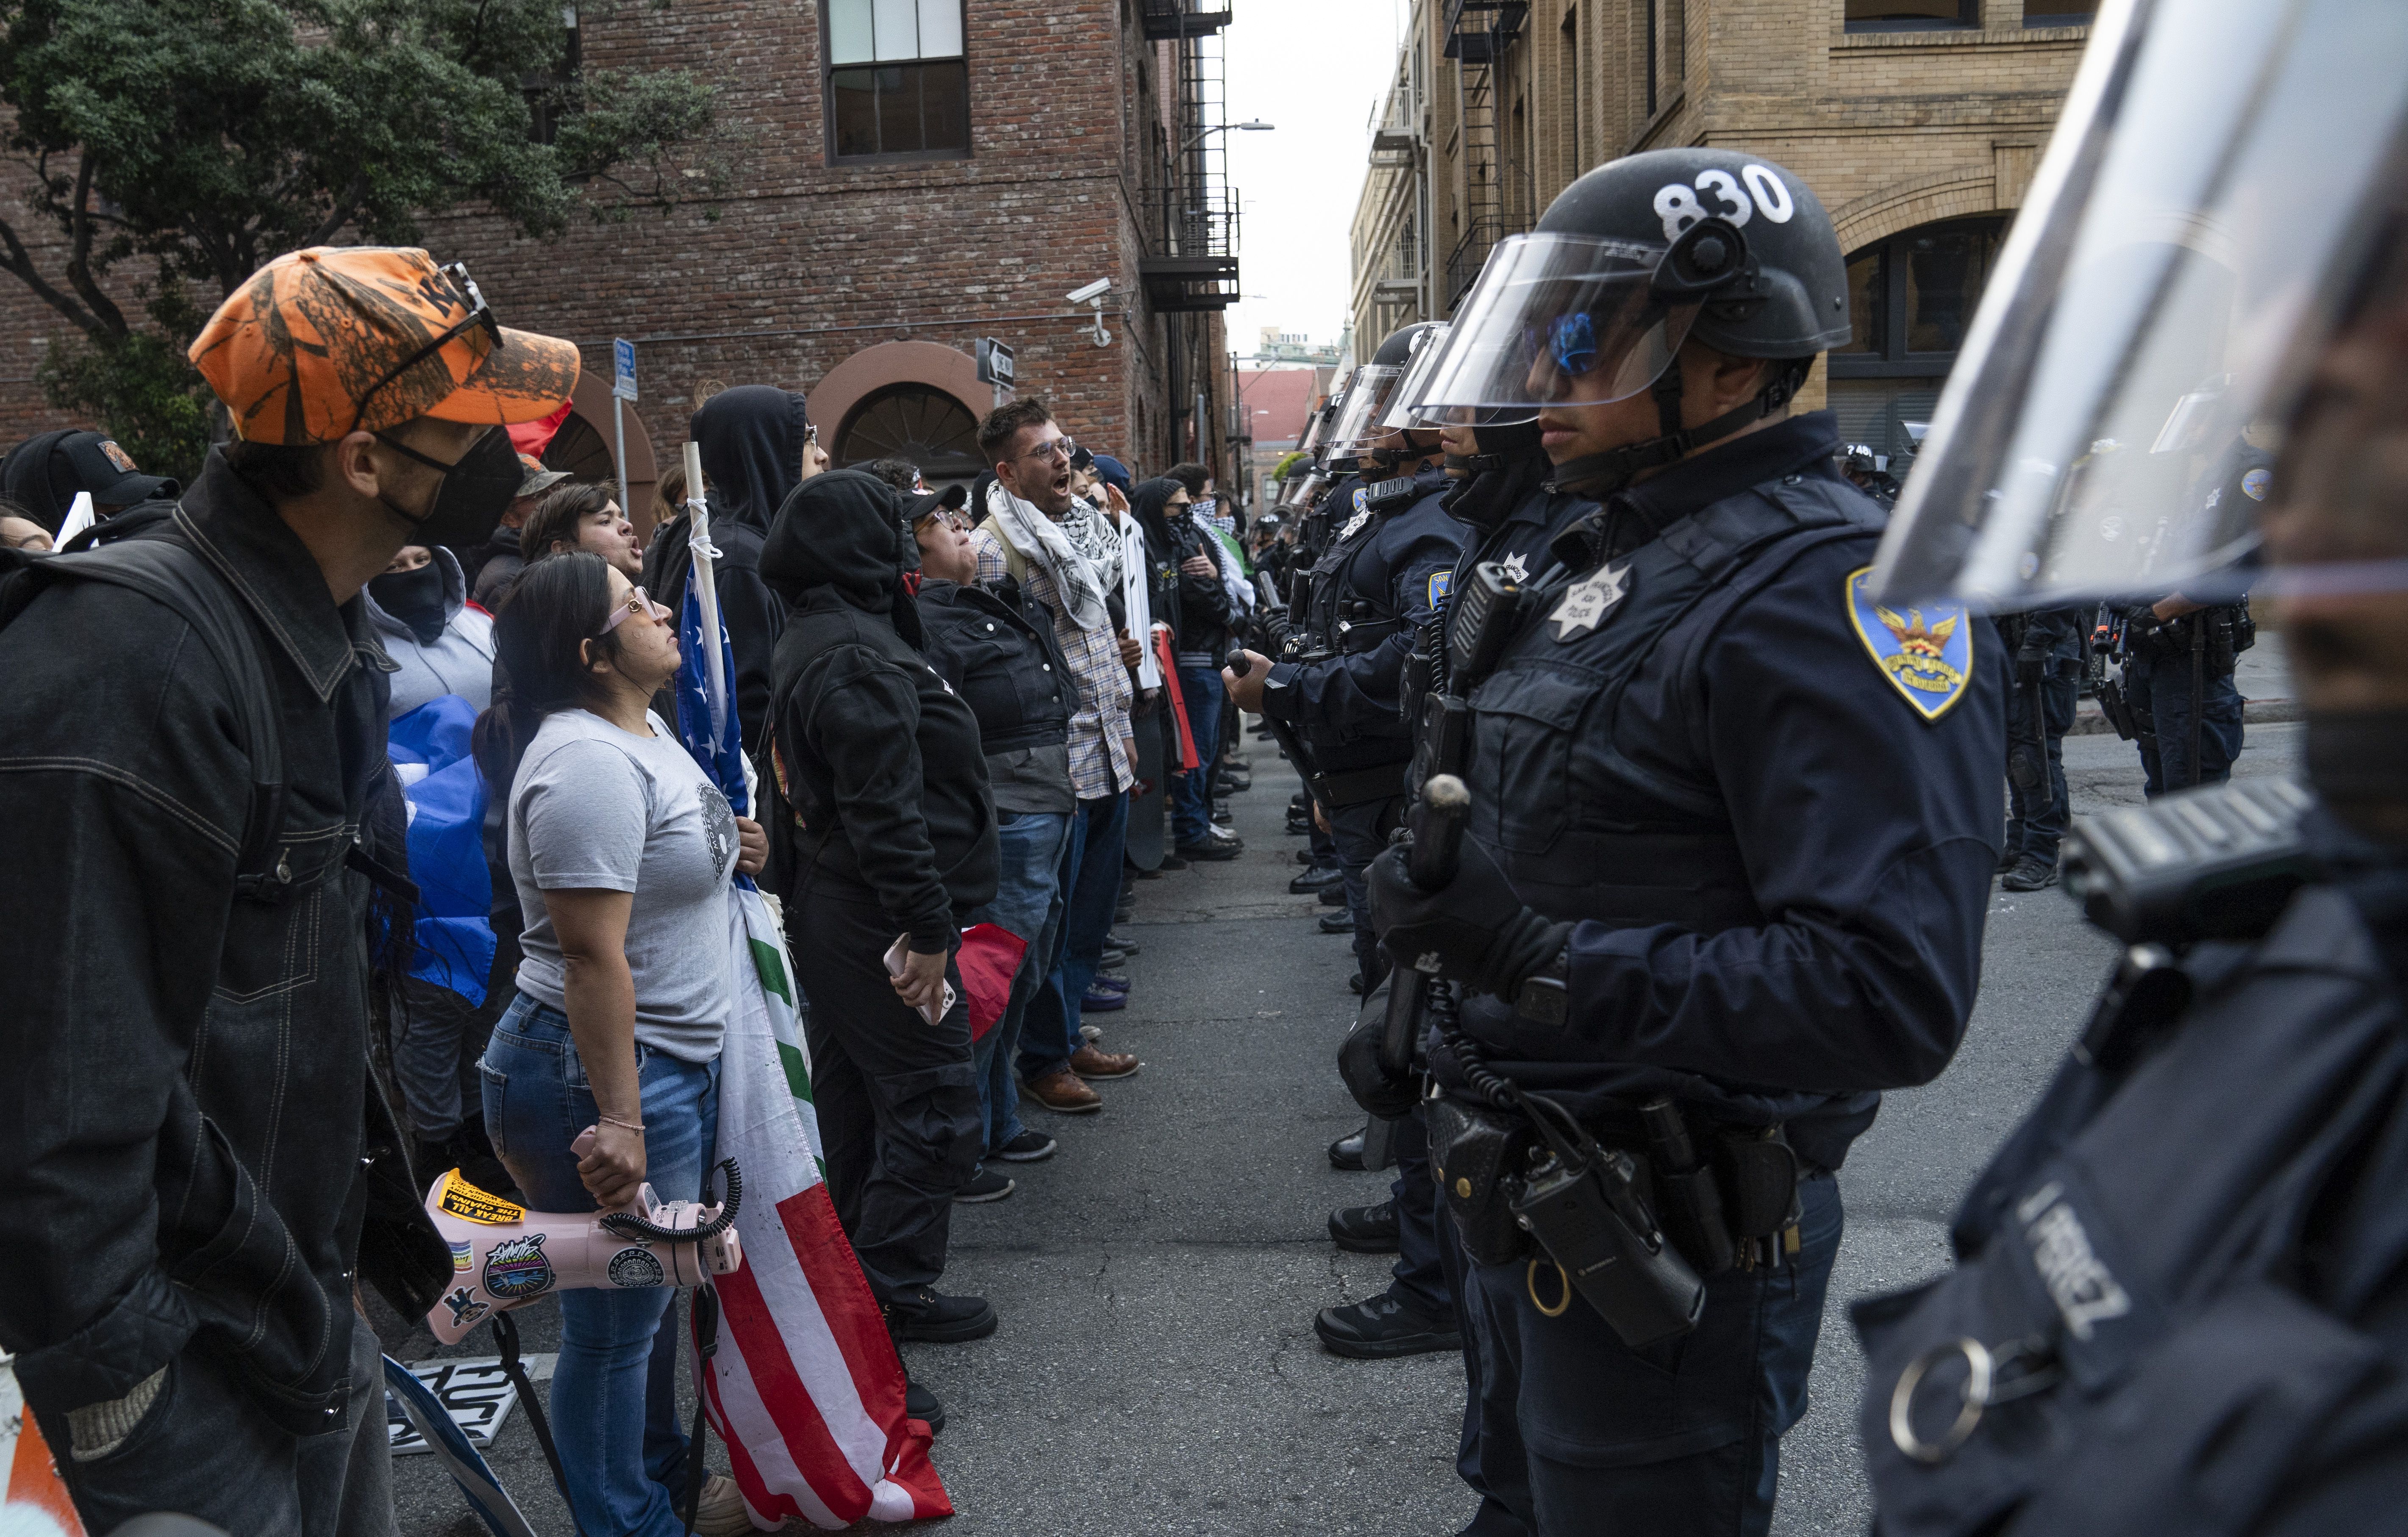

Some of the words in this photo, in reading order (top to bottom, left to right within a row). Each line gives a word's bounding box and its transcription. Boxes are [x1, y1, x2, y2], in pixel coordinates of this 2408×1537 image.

[1654, 164, 1794, 244] 830
[1506, 564, 1522, 579] FRANCISCO
[1434, 574, 1448, 584] SAN
[706, 817, 719, 849] MORE
[718, 857, 723, 871] NO
[448, 1187, 468, 1196] FURY
[468, 1190, 497, 1201] WOMEN
[446, 1193, 494, 1211] CHAINS!
[453, 1202, 473, 1214] ALL
[486, 1200, 519, 1209] UNLEASH
[474, 1209, 514, 1221] BREAK
